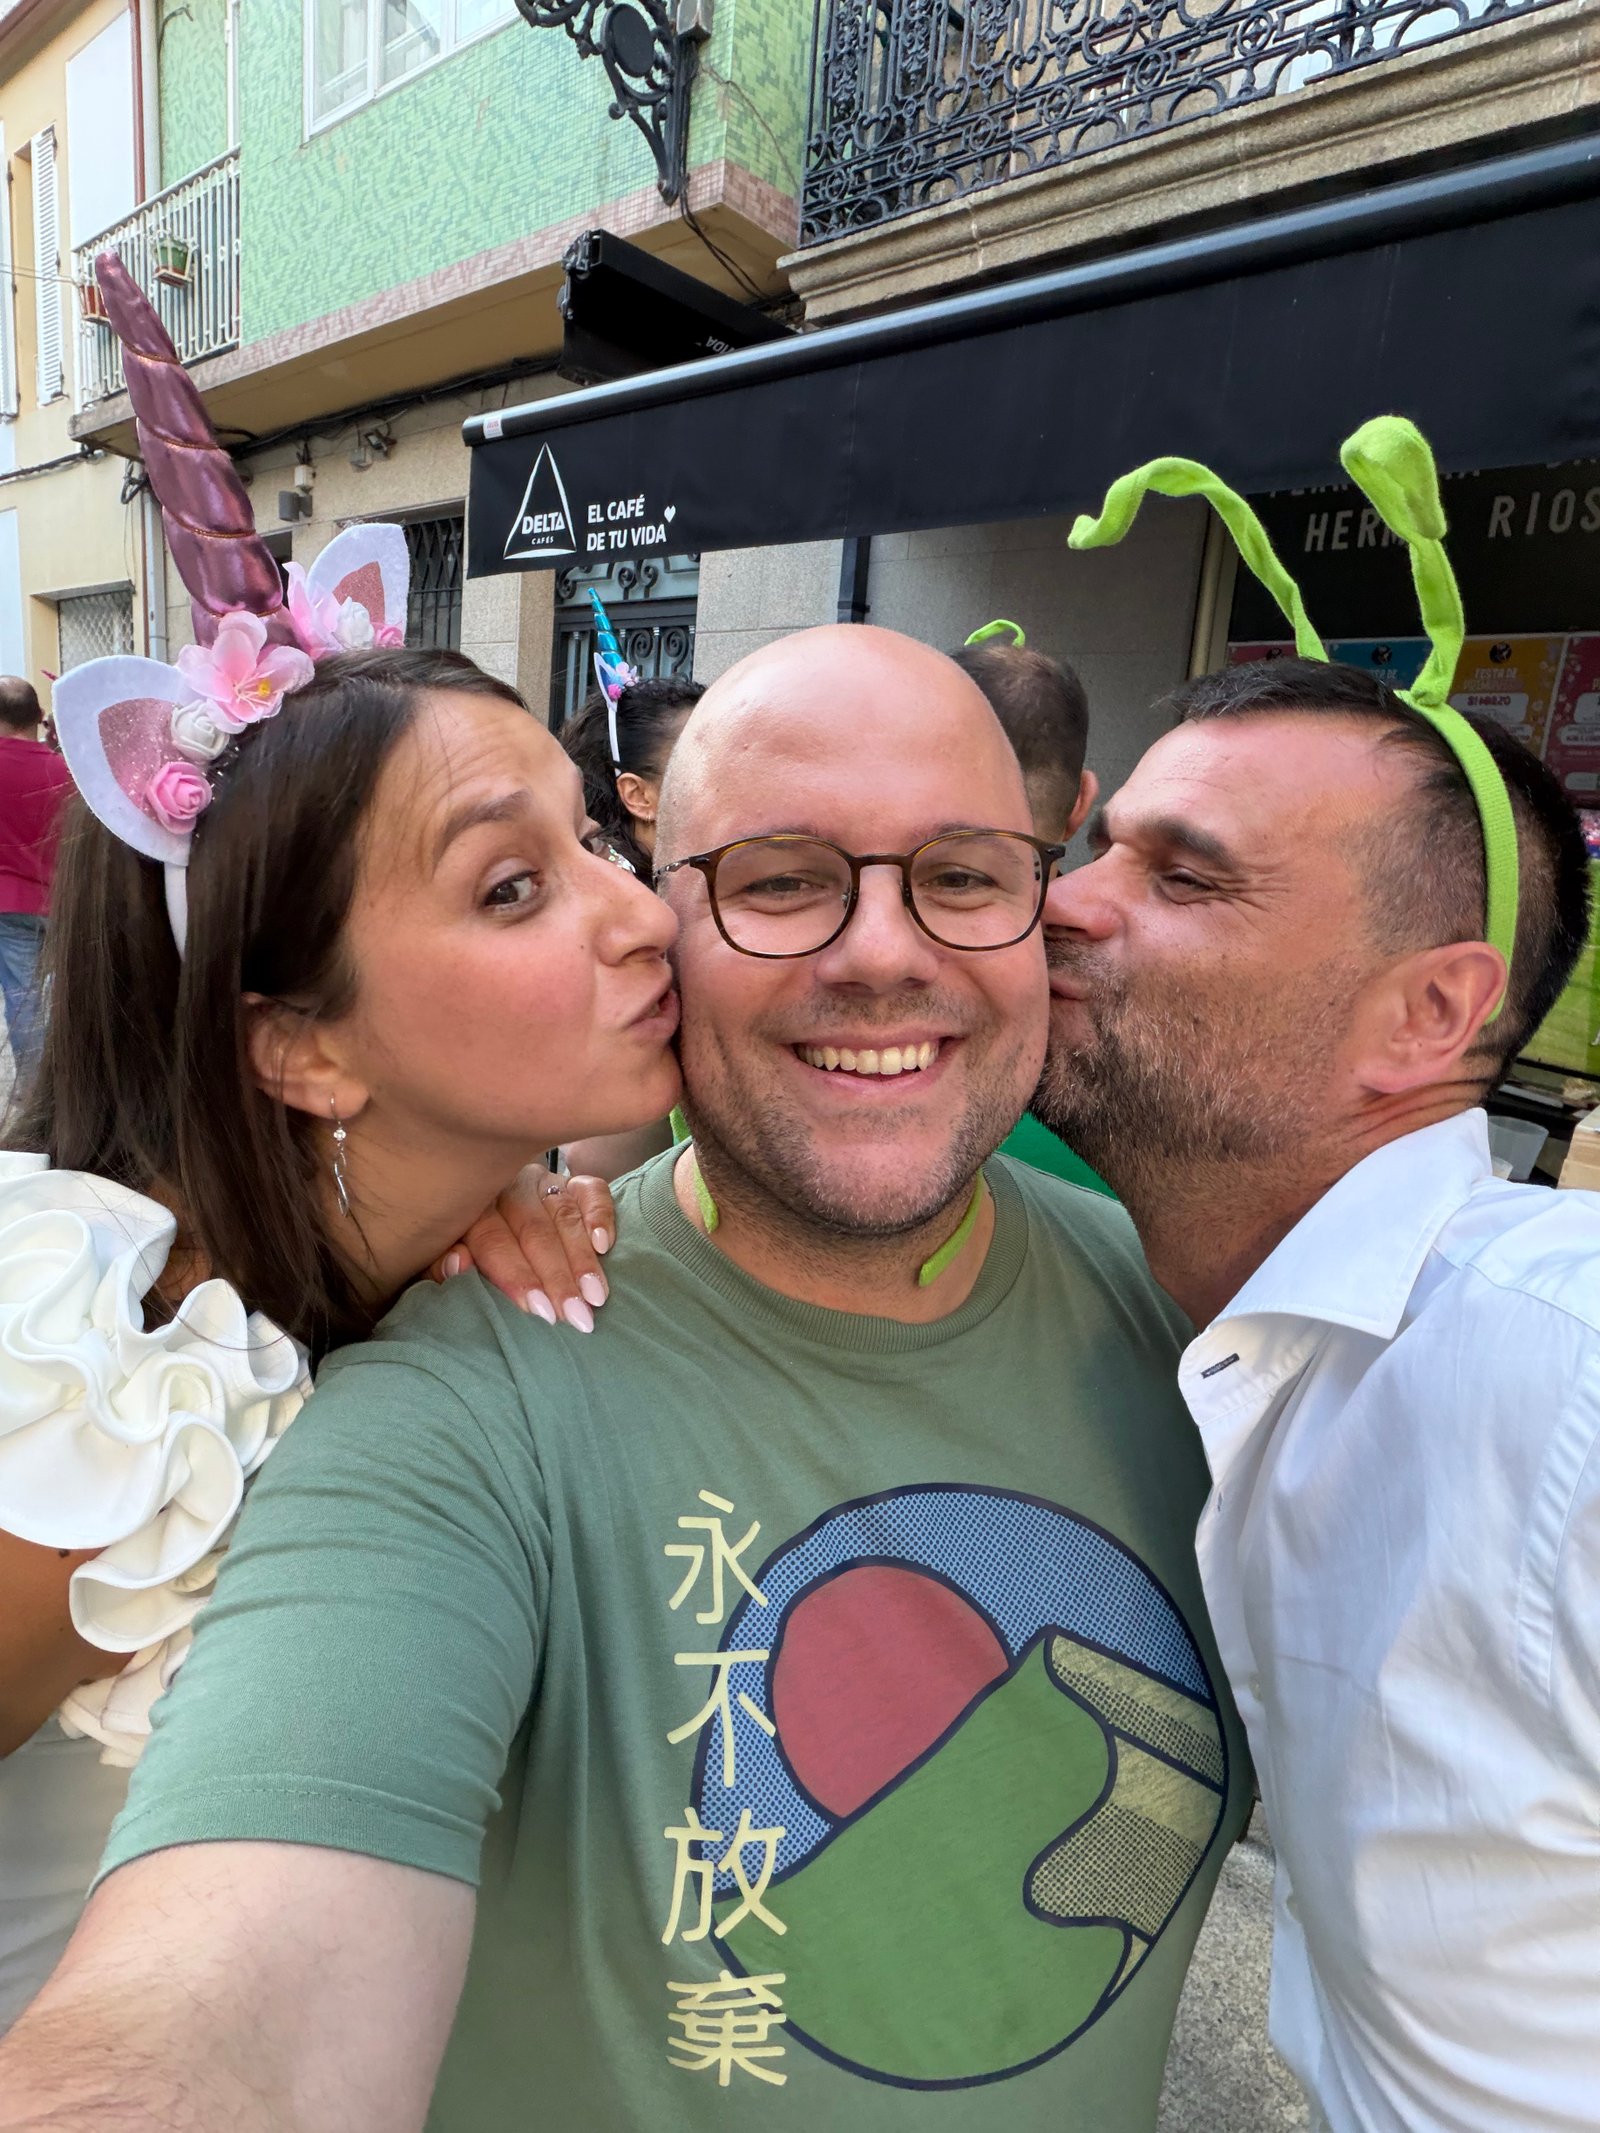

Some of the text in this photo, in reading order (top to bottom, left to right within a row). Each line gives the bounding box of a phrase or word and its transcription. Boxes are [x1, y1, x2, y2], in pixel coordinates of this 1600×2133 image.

[521, 511, 566, 535] DELTA
[587, 494, 646, 524] EL CAFÉ
[1488, 487, 1600, 538] RIOS
[586, 523, 668, 552] DE TU VIDA
[662, 1488, 788, 2088] 永不放棄
